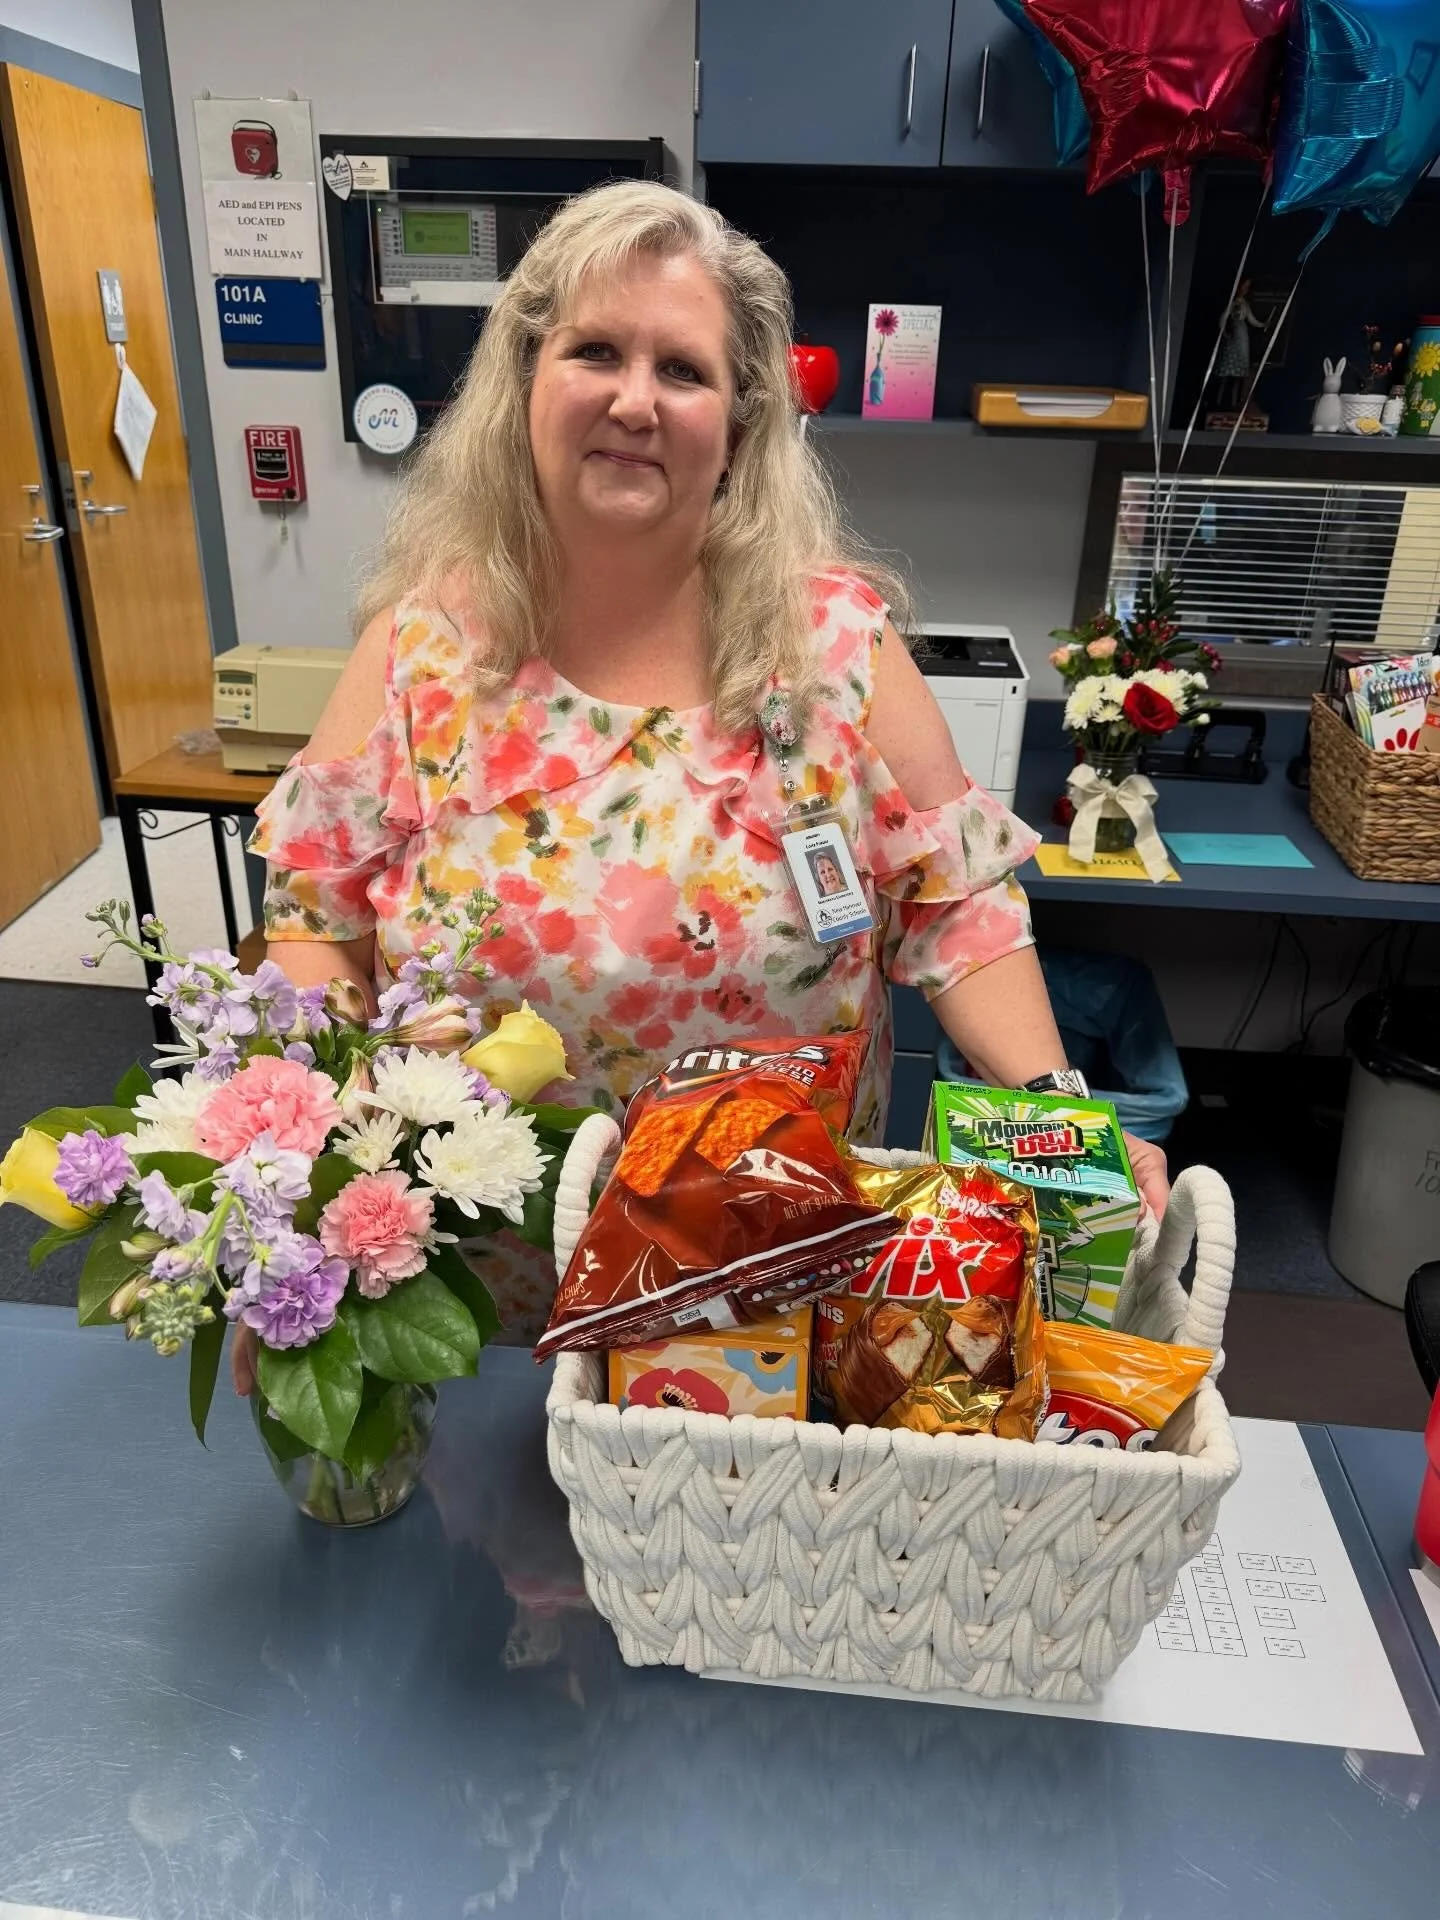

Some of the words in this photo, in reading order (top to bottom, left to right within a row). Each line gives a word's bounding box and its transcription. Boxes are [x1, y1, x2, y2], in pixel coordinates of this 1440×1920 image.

[218, 199, 240, 209] AED
[241, 201, 257, 210] and
[259, 201, 275, 210] EPI
[277, 202, 303, 211] PENS
[237, 216, 286, 227] LOCATED
[256, 233, 268, 242] IN
[224, 248, 251, 257] MAIN
[253, 249, 304, 260] HALLWAY
[221, 285, 267, 303] 101A
[224, 312, 263, 325] CLINIC
[249, 430, 289, 447] FIRE
[1008, 1161, 1081, 1184] mini
[783, 1203, 800, 1220] NET
